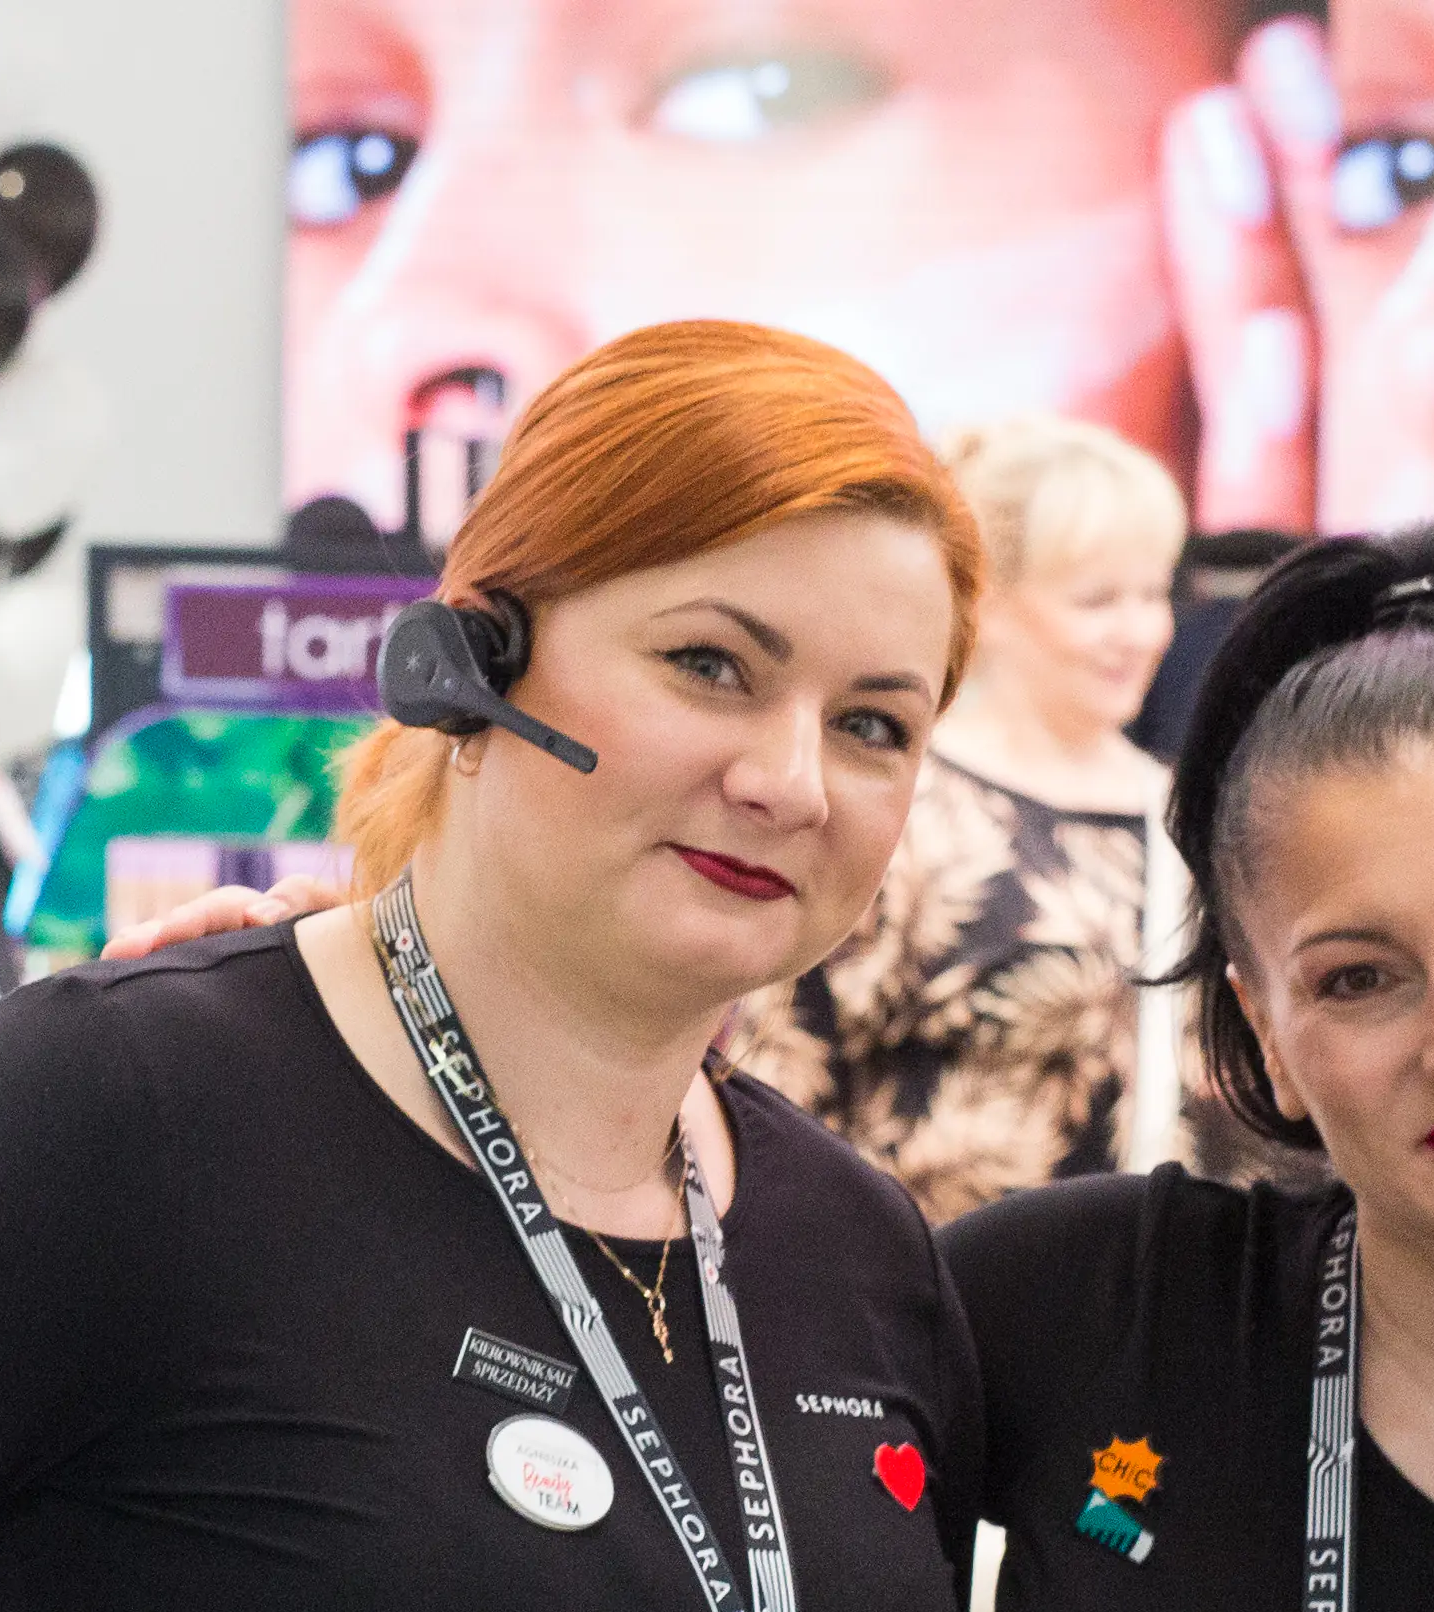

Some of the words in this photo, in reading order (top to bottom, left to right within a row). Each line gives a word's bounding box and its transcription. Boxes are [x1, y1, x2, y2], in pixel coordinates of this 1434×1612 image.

[260, 597, 405, 682] tar
[719, 1357, 775, 1541] SEPHORA
[795, 1393, 885, 1420] SEPHORA
[623, 1405, 732, 1604] SEPHORA
